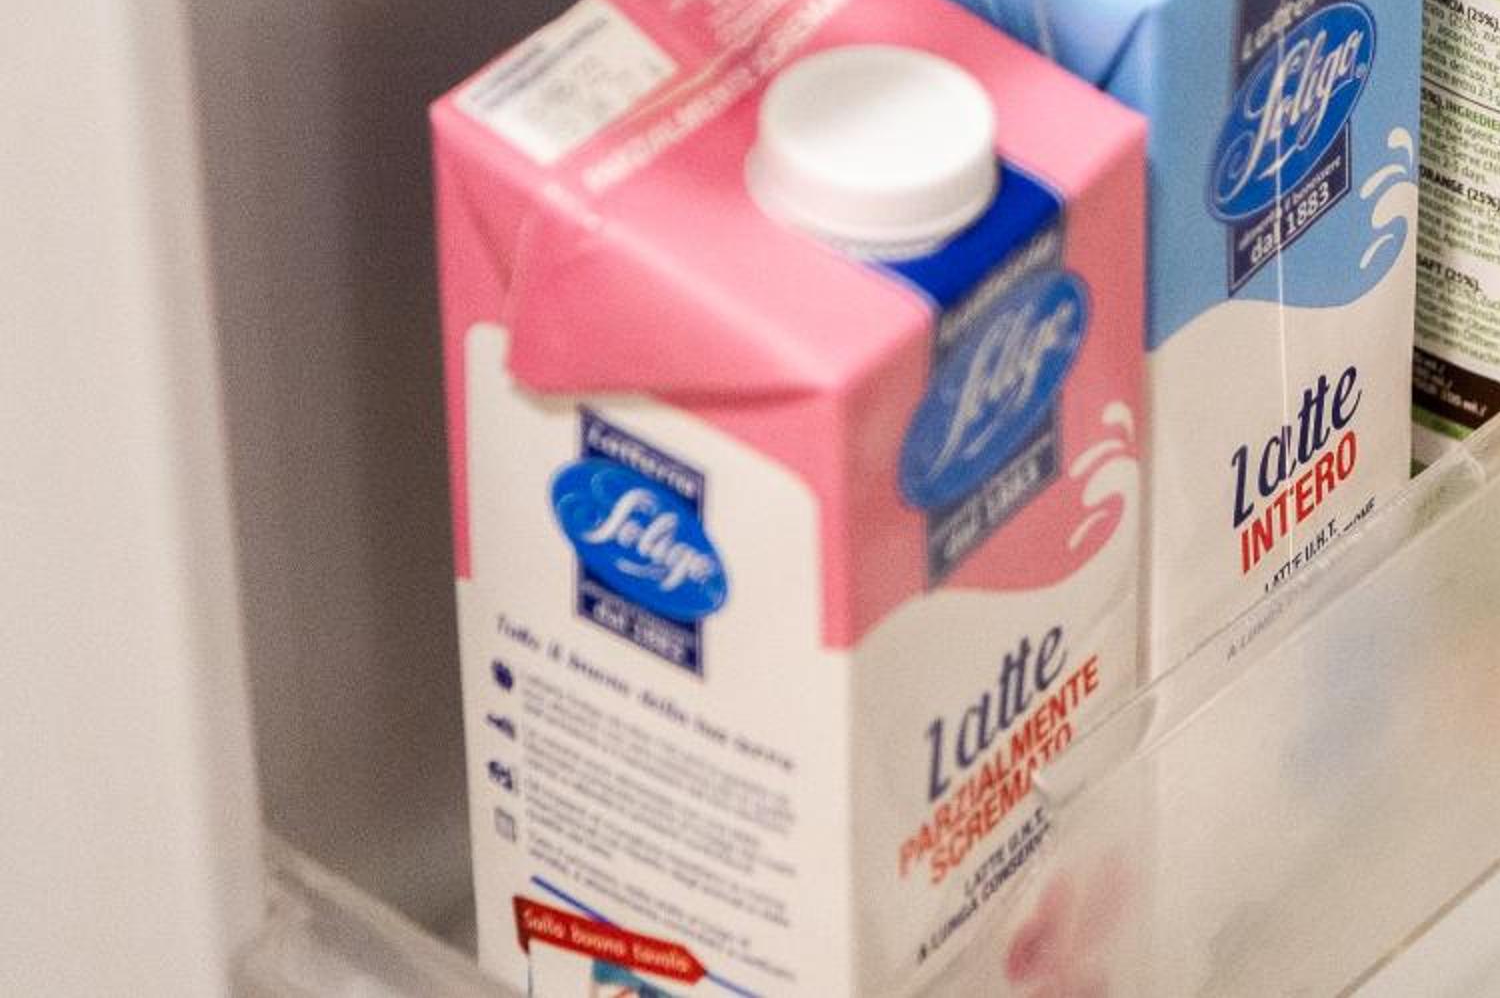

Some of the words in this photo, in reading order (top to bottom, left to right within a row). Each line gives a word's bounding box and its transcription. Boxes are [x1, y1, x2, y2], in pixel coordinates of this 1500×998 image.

[1250, 216, 1281, 263] dal
[1284, 182, 1330, 236] 1883
[1231, 365, 1362, 529] Latte
[1240, 430, 1357, 576] INTERO
[898, 655, 1101, 879] PARZIALMENTE
[925, 625, 1067, 802] Latte
[930, 721, 1073, 886] SCREMATO
